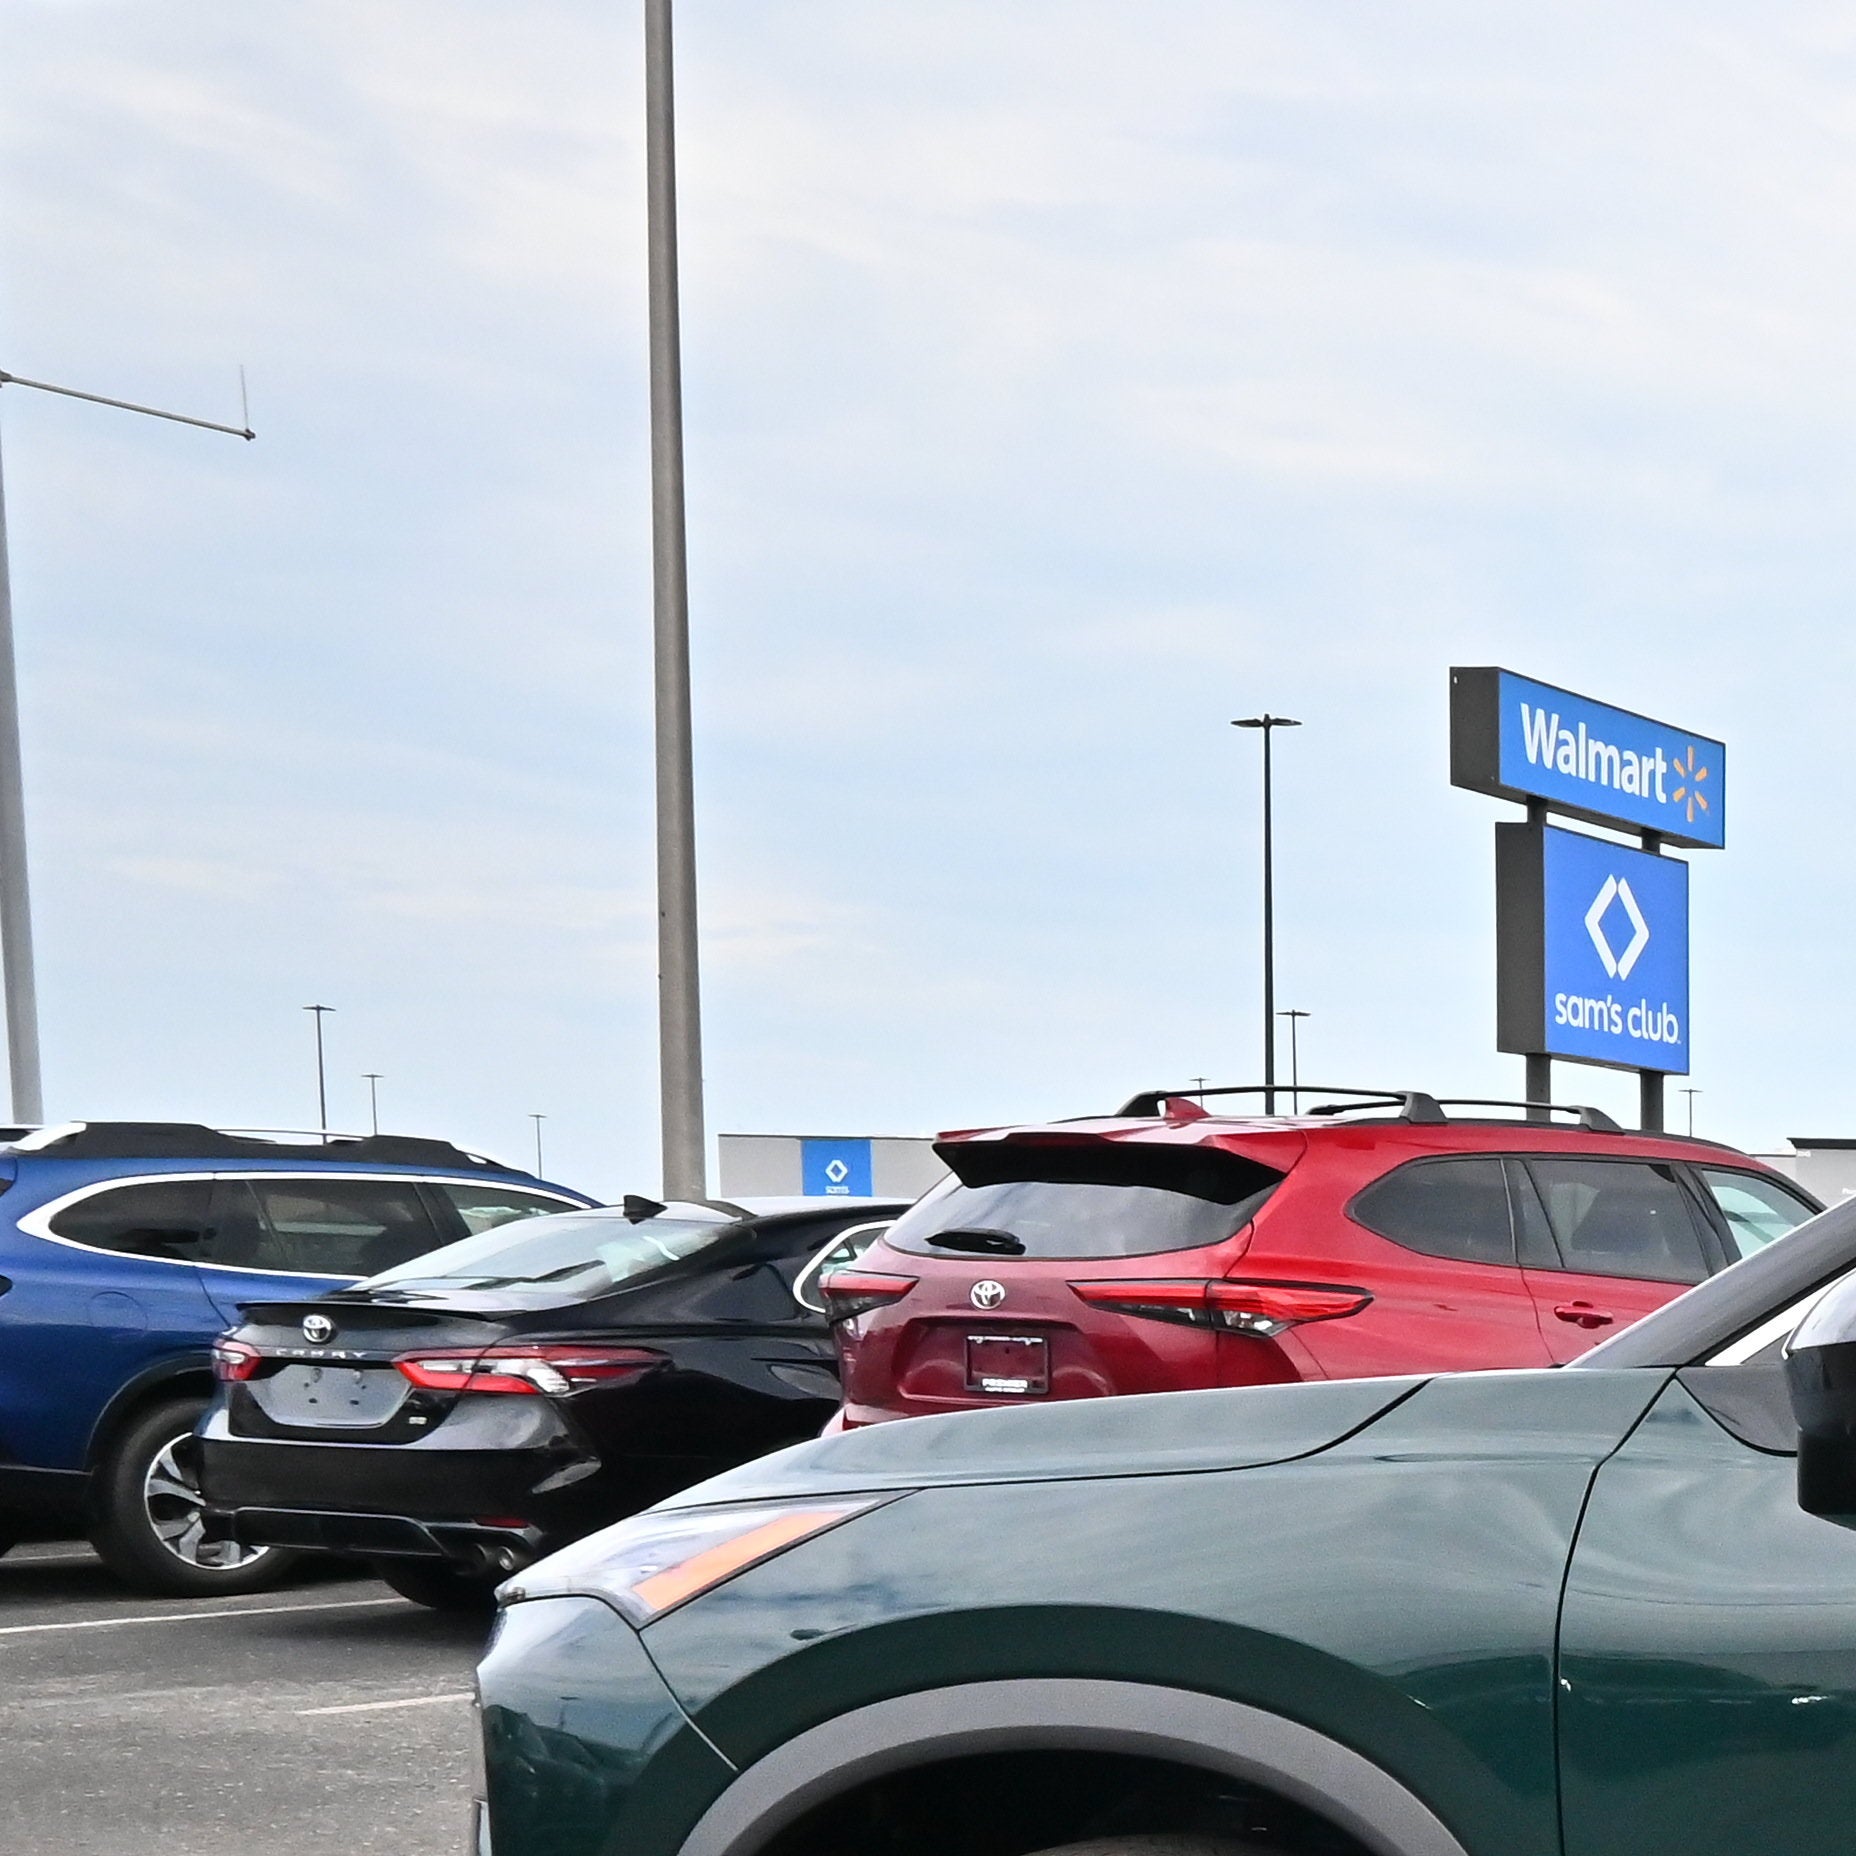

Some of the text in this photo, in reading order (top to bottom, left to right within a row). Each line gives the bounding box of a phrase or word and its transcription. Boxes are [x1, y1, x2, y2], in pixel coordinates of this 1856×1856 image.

[1520, 702, 1668, 804] Walmart
[1554, 992, 1679, 1044] sam's club
